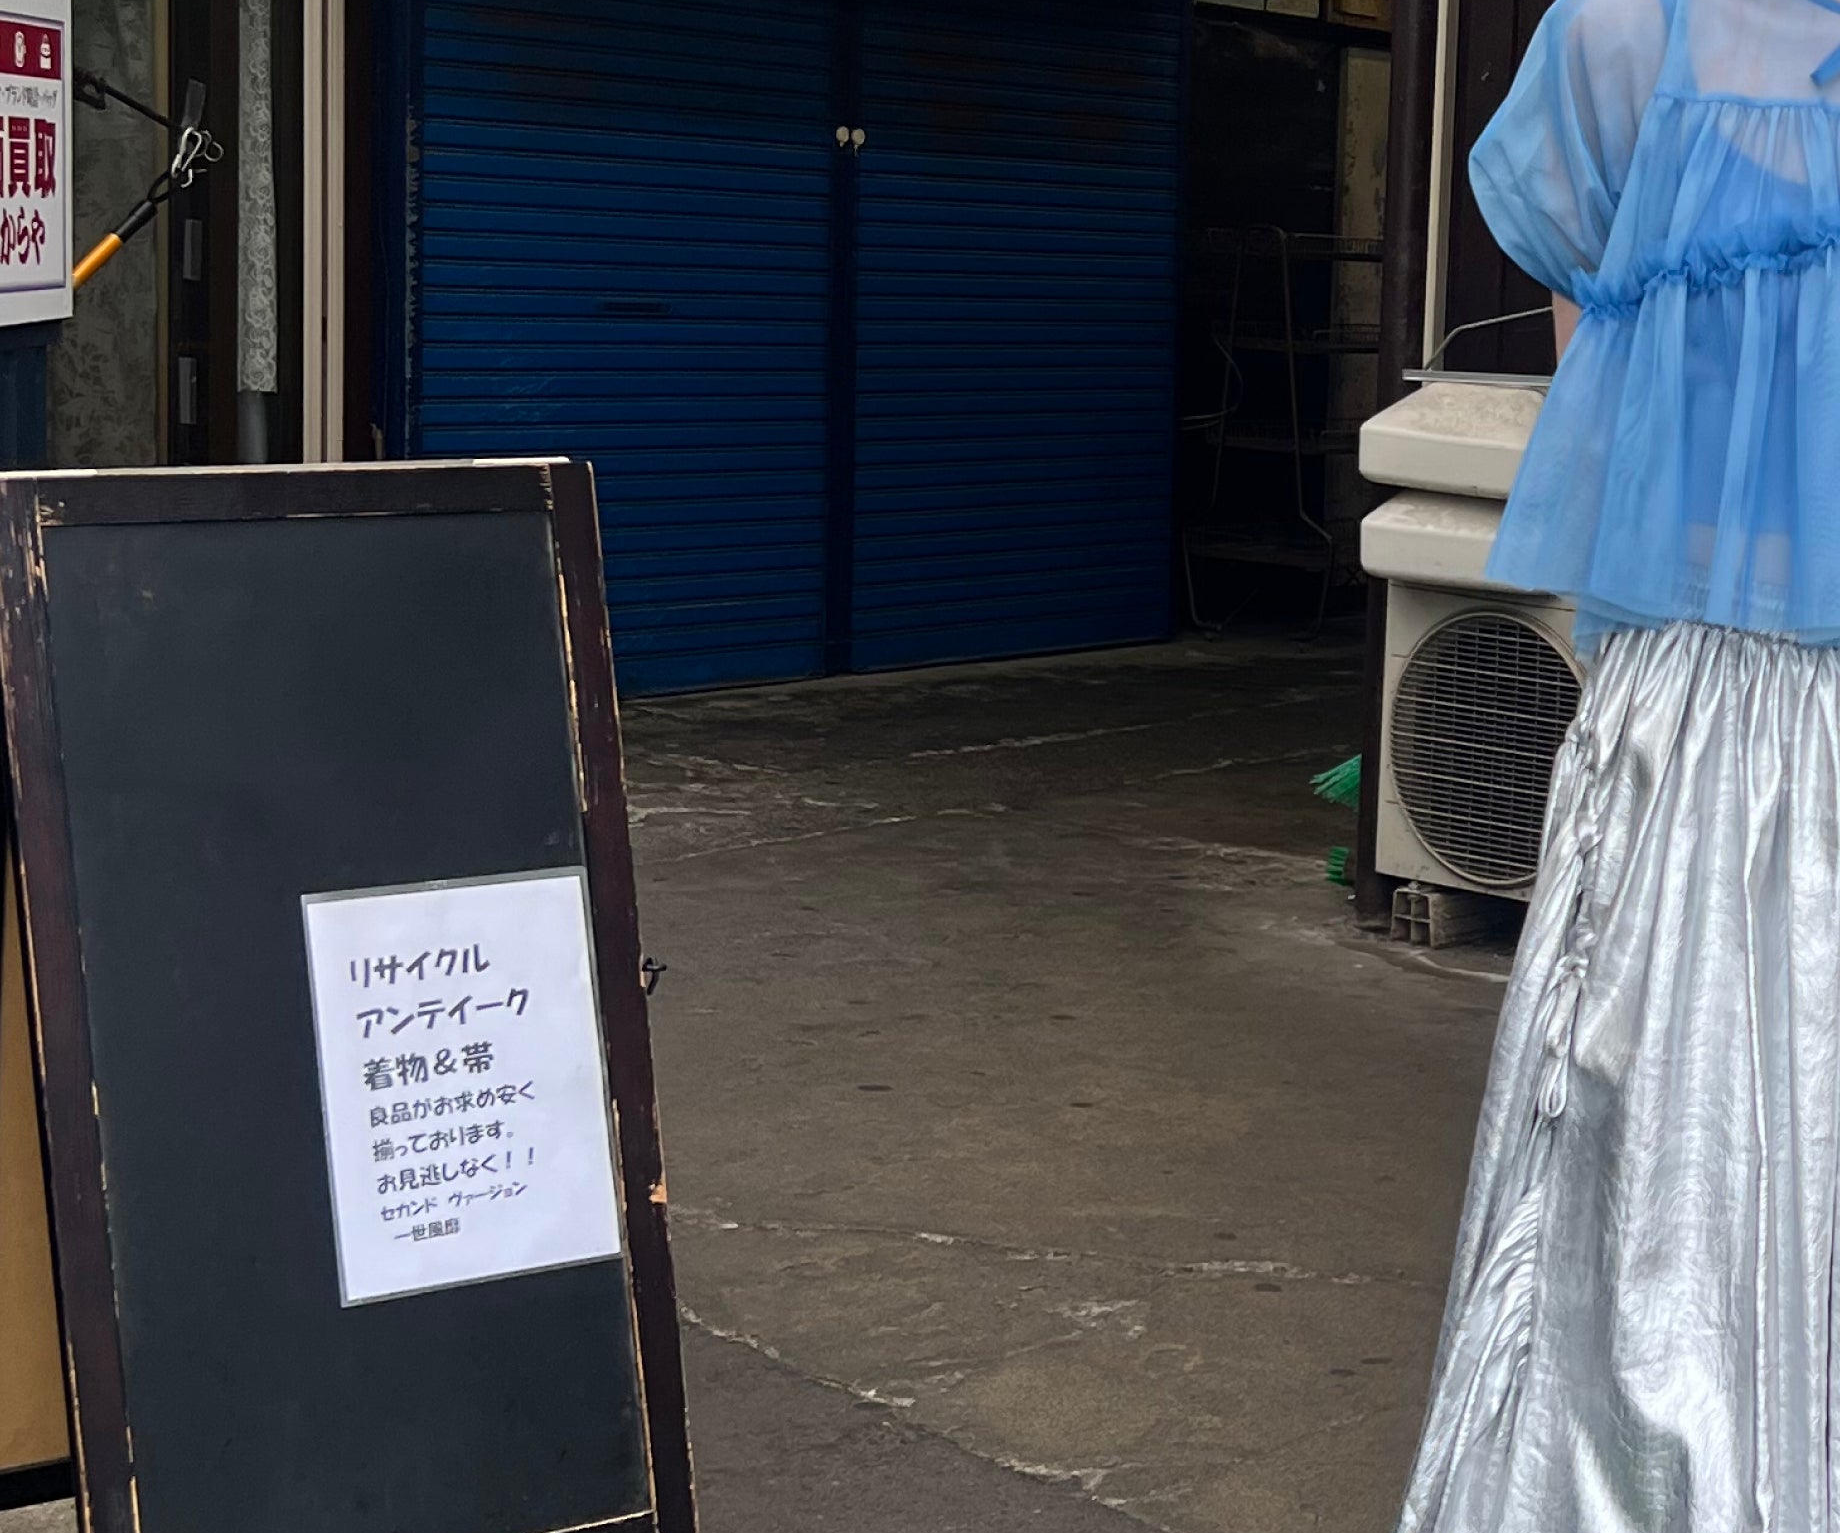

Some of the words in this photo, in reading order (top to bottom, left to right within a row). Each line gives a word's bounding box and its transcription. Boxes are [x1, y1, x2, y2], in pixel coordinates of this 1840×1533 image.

[0, 115, 57, 199] 買取
[349, 943, 490, 988] リサイクル
[369, 1080, 536, 1128] 良品がお求め安く
[380, 1197, 438, 1223] セカンド
